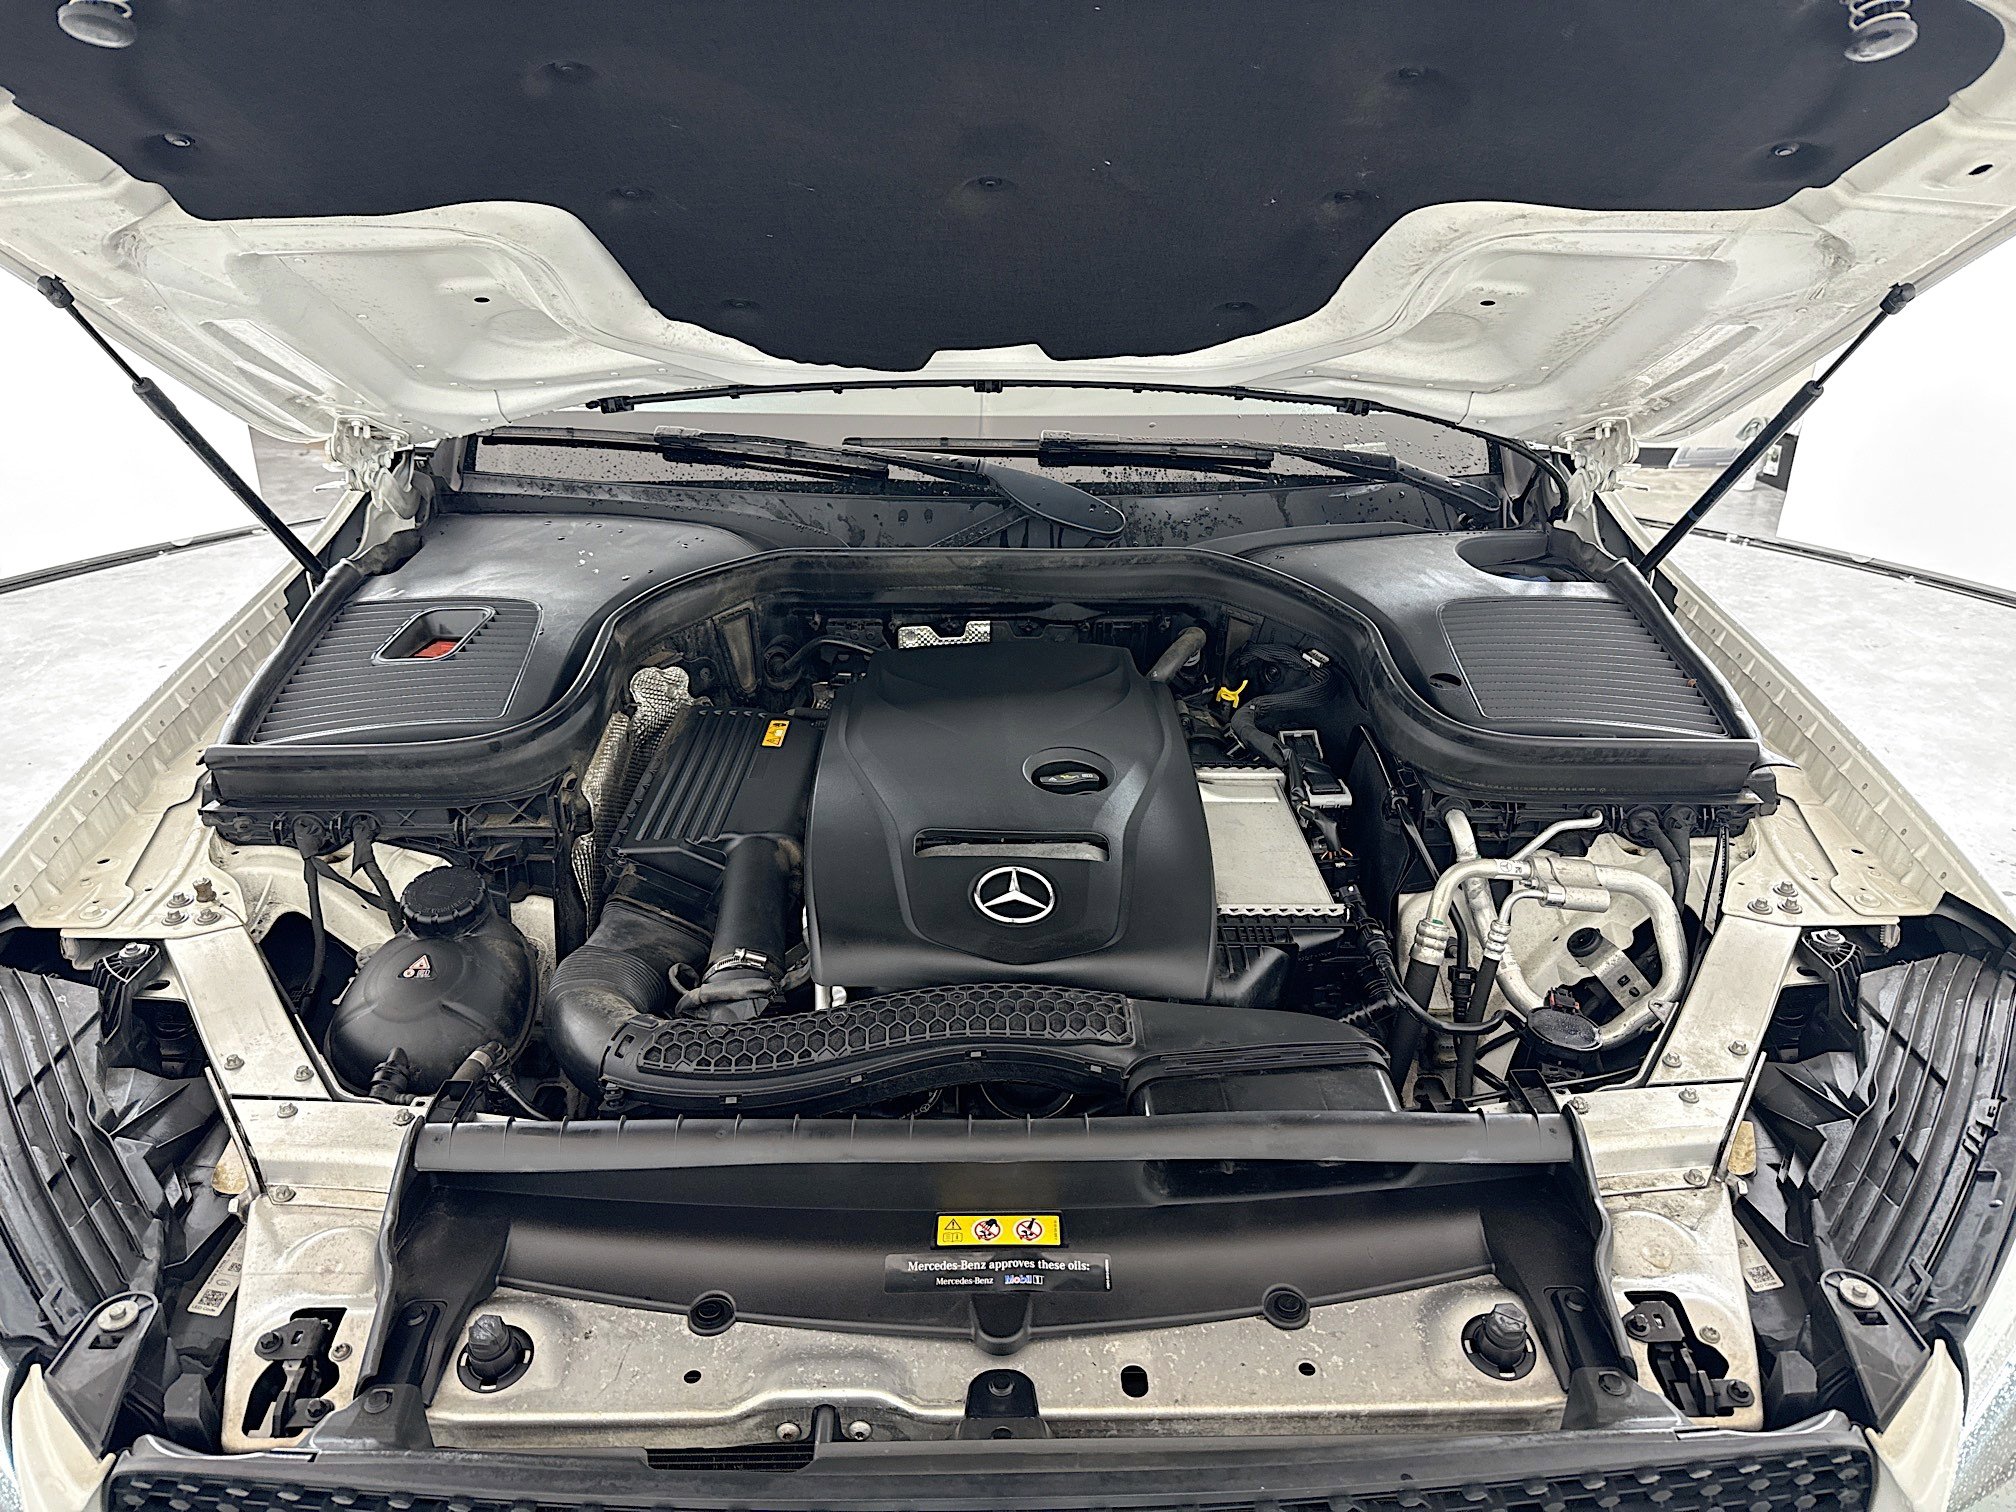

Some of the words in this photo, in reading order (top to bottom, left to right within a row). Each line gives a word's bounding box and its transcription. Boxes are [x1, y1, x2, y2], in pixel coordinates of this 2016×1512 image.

[908, 1260, 986, 1272] Mercedes-Benz
[989, 1260, 1035, 1271] approves
[1038, 1260, 1065, 1270] these
[1068, 1260, 1090, 1271] oils:
[936, 1276, 994, 1285] Mercedes-Benz
[1005, 1275, 1032, 1285] Mobil
